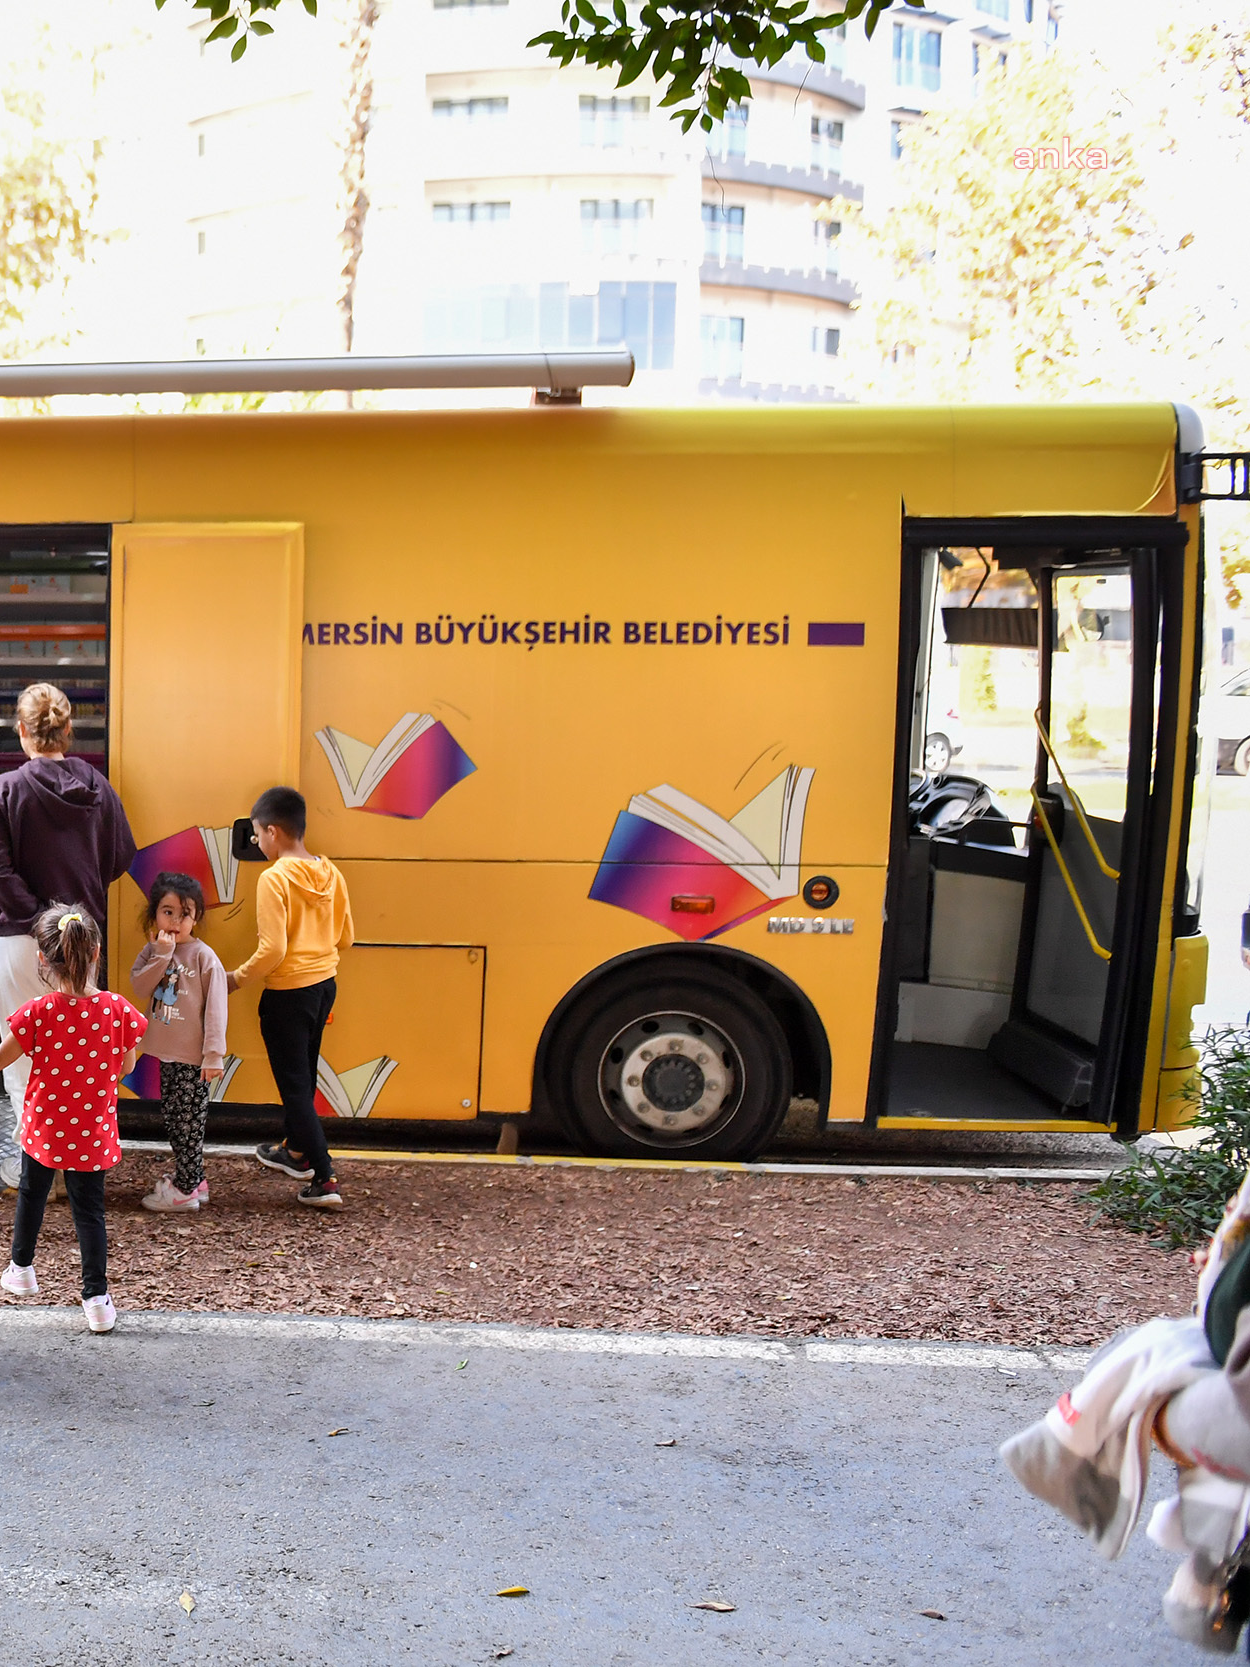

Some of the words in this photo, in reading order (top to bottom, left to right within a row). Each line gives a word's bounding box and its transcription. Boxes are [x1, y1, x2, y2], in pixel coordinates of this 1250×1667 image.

[415, 614, 611, 651] BÜYÜKŞEHİR
[623, 614, 789, 645] BELEDİYESİ
[767, 916, 805, 934] MD
[830, 918, 855, 935] LE
